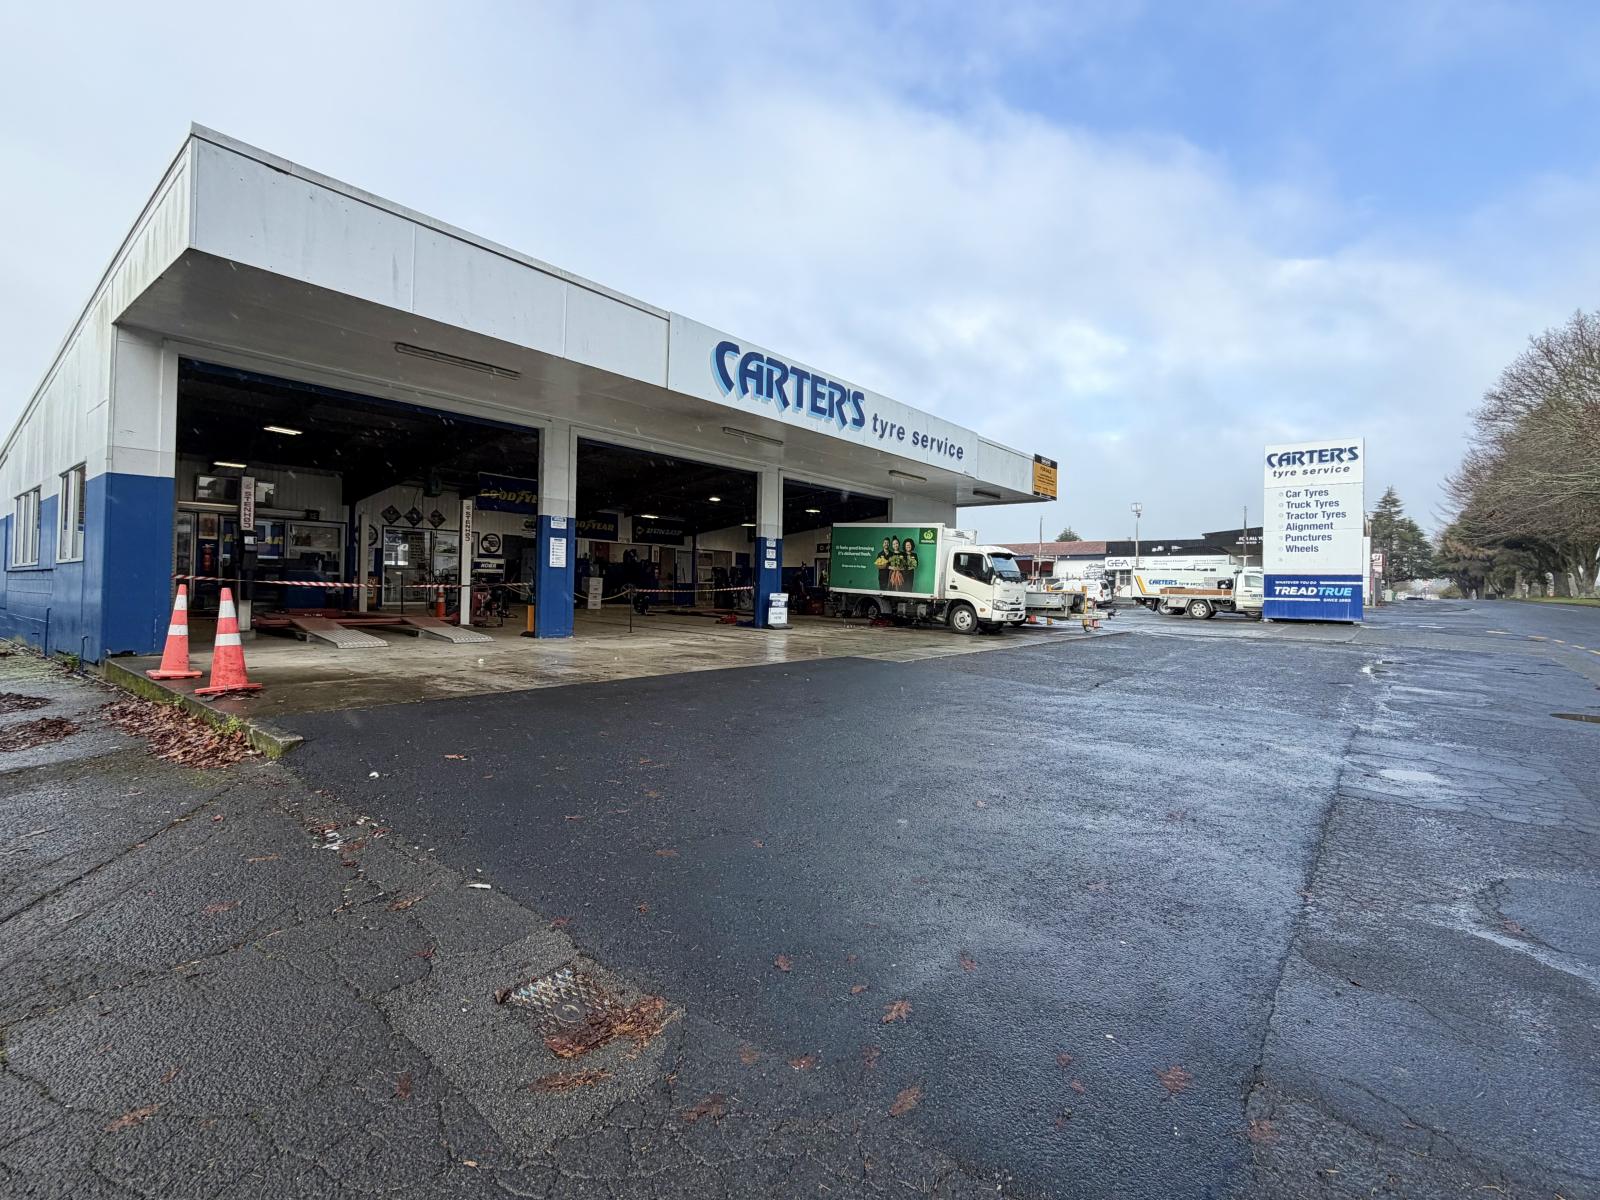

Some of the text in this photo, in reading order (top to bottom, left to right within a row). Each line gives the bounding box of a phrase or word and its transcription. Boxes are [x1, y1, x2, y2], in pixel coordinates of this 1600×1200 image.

[711, 341, 866, 432] CARTER'S
[872, 413, 965, 460] tyre service
[1266, 446, 1359, 468] CARTER'S
[1273, 466, 1351, 479] tyre service
[1285, 489, 1329, 499] Car Tyres
[1286, 500, 1340, 509] Truck Tyres
[1286, 511, 1347, 520] Tractor Tyres
[1286, 522, 1334, 532] Alignment
[1285, 534, 1333, 542] Punctures
[1274, 587, 1352, 596] TREADTRUE
